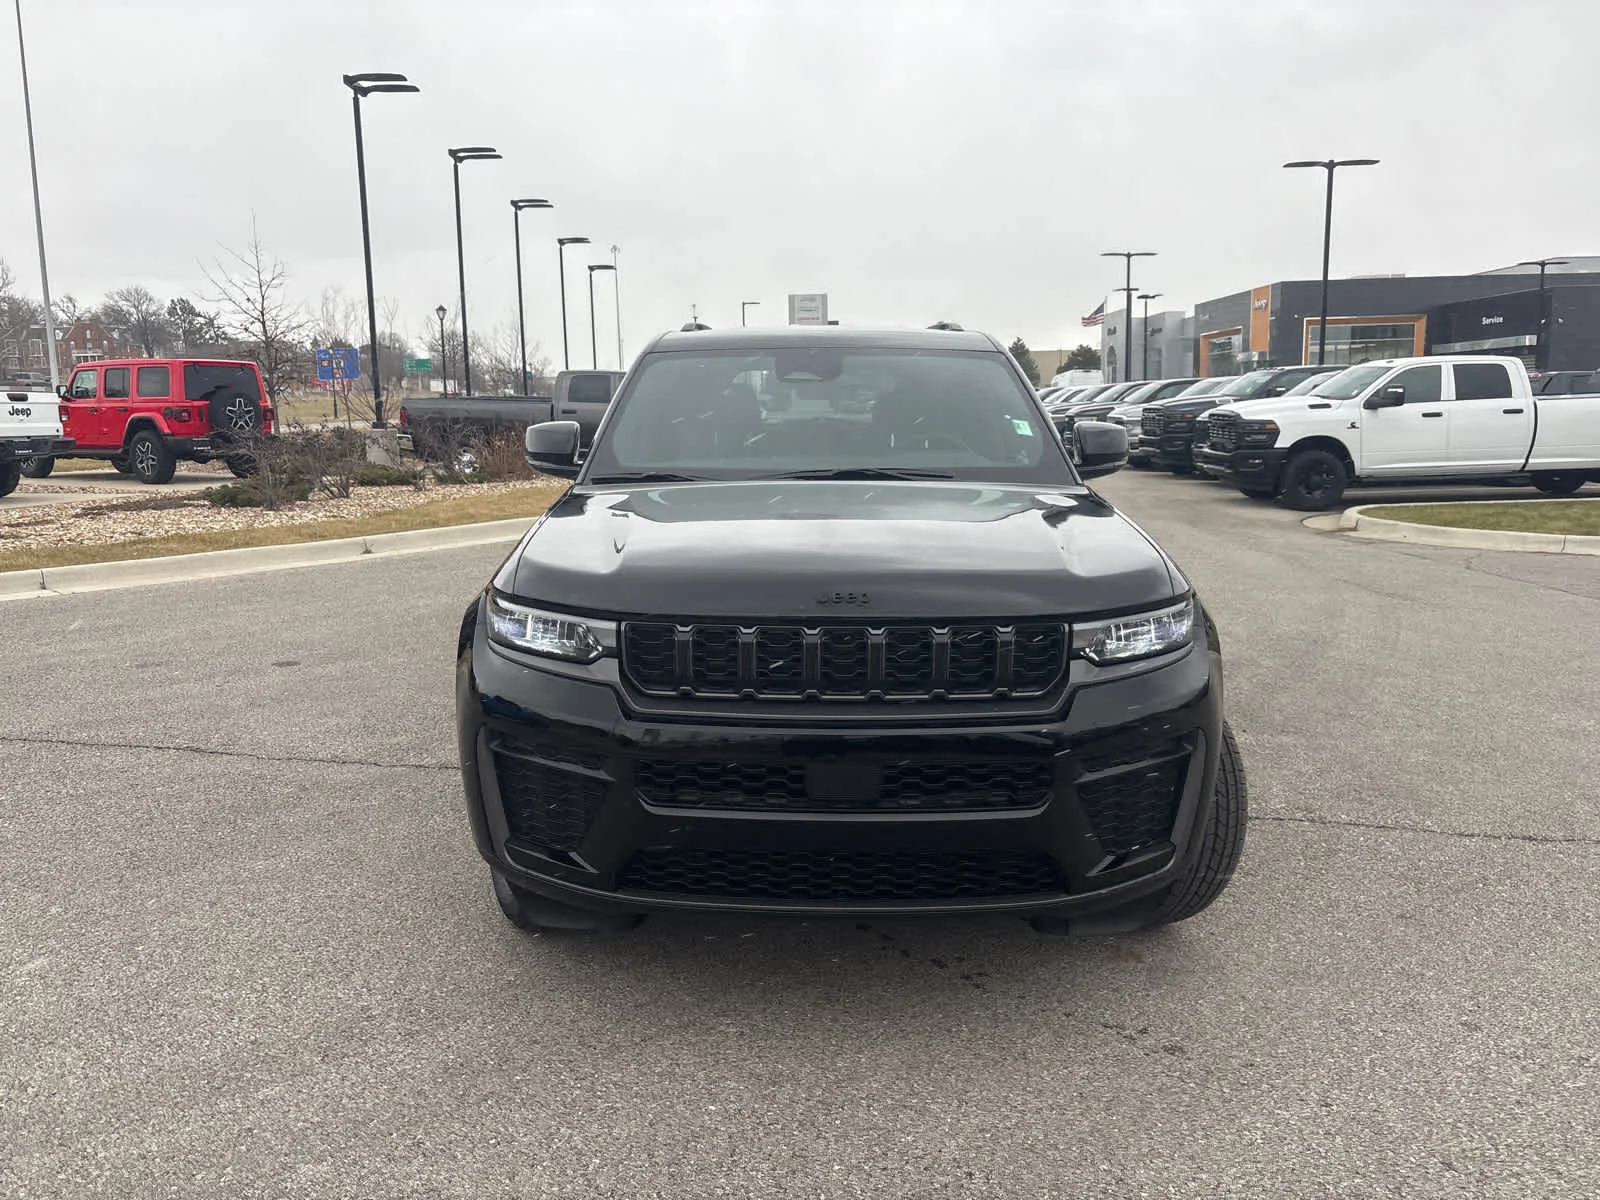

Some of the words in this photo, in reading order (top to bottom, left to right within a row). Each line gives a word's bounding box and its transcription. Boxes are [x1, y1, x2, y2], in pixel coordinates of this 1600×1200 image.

[1481, 315, 1504, 325] Service
[8, 405, 32, 418] Jeep
[816, 591, 870, 608] Jeep
